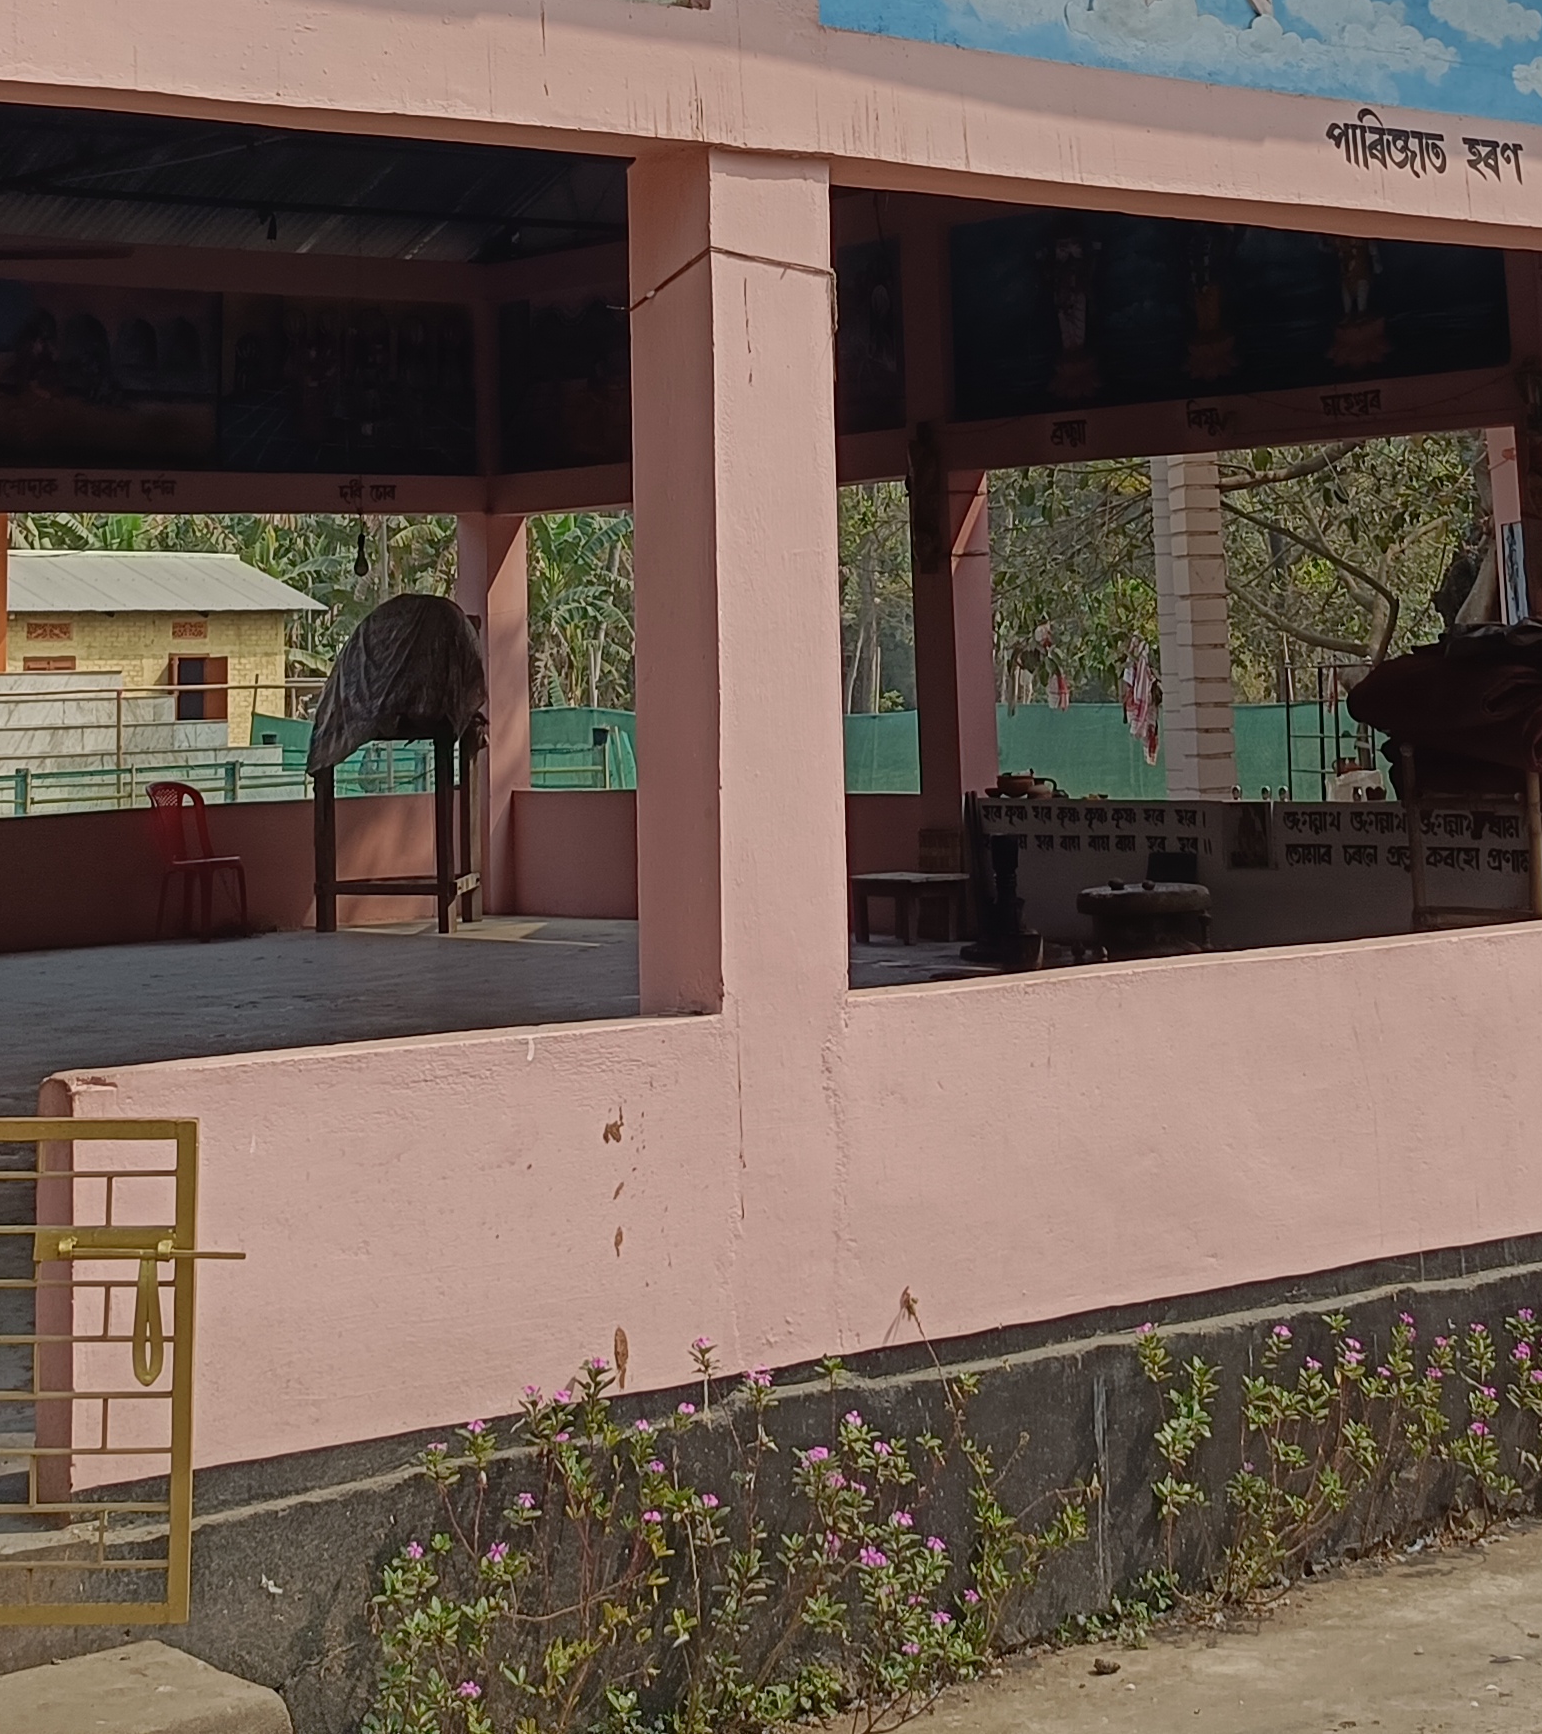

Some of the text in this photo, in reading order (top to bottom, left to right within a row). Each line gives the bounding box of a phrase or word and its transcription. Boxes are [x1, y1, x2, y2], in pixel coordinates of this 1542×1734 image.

[1326, 108, 1523, 185] পাৰিজাত হৰণ
[1283, 811, 1341, 835] জগন্নাথ
[1350, 811, 1408, 834] জগন্নাথ
[1285, 844, 1332, 866] তোমাৰ
